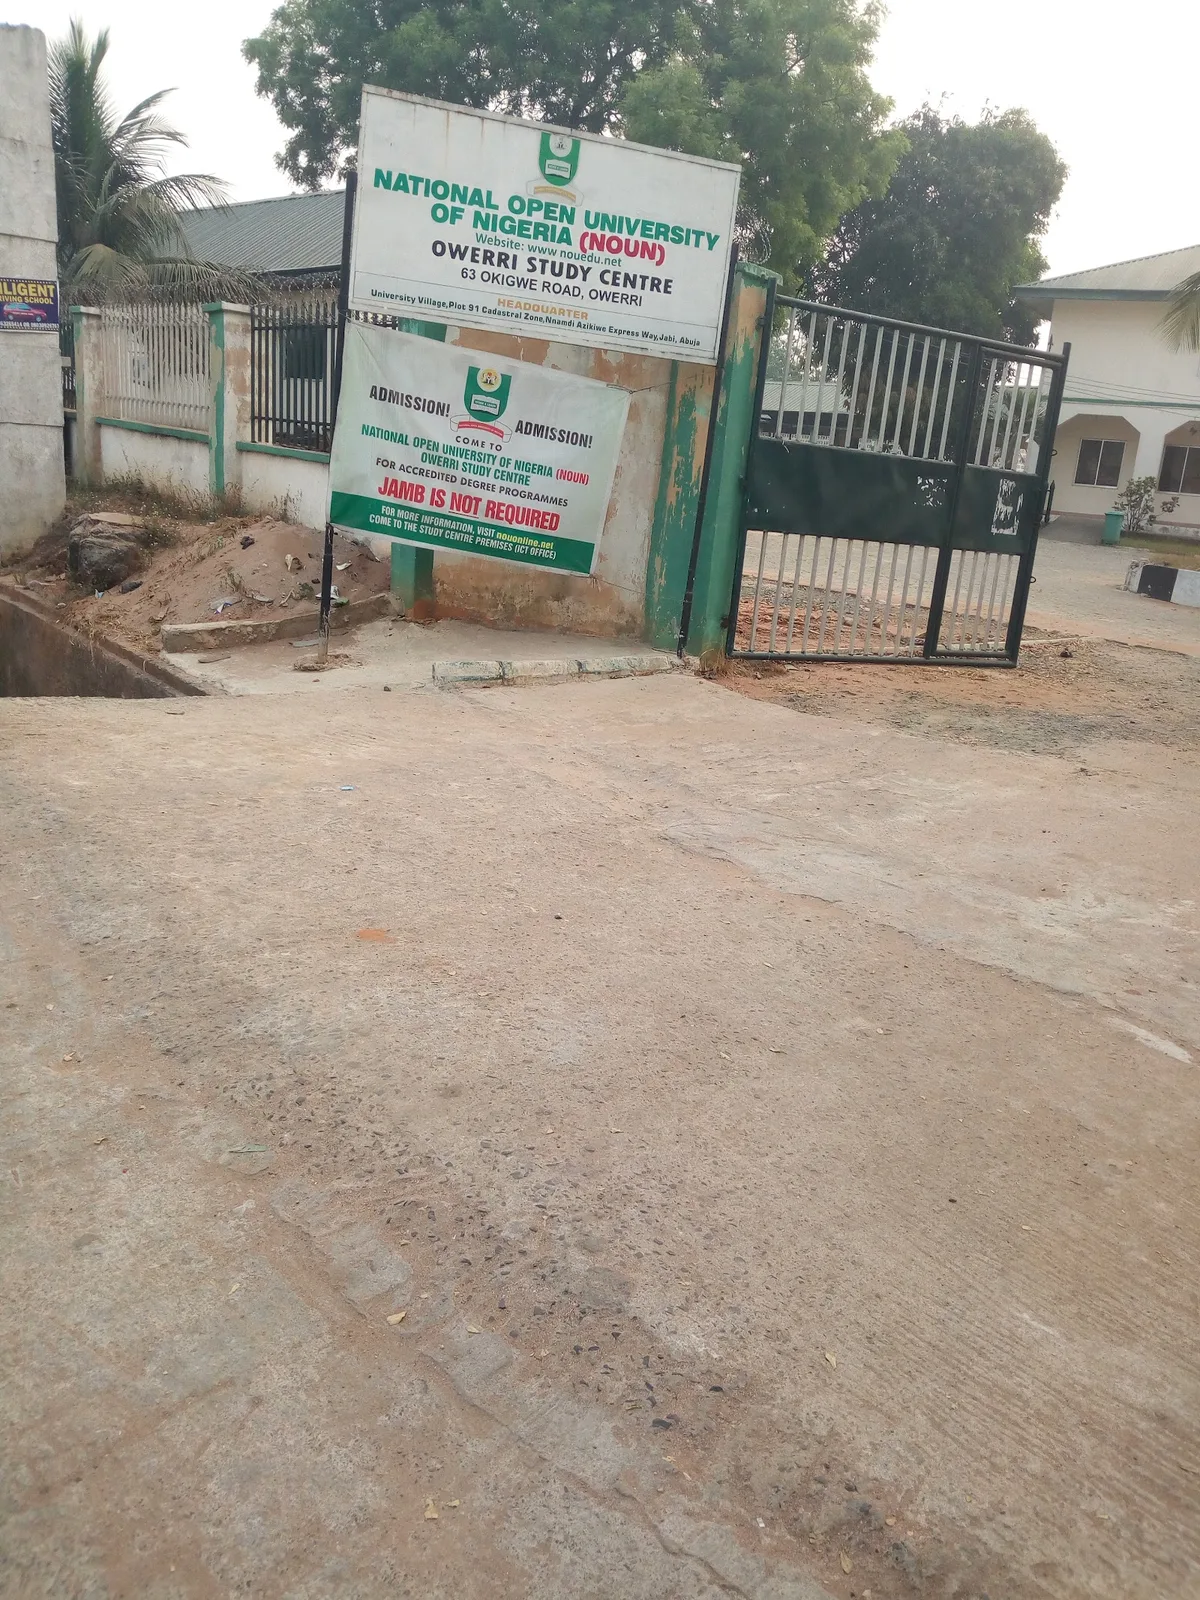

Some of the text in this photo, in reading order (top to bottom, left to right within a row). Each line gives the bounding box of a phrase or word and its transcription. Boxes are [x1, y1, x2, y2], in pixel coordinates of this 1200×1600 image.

[374, 168, 720, 251] NATIONAL OPEN UNIVERSITY
[431, 203, 666, 266] OF NIGERIA (NOUN)
[475, 233, 524, 250] Website:
[432, 240, 673, 294] OWERRI STUDY CENTRE
[461, 268, 642, 306] 63 OKIGWE ROAD, OWERRI
[25, 296, 54, 304] SCHOOL
[371, 289, 416, 304] University
[468, 304, 479, 312] 91
[482, 306, 522, 319] Cadastral
[576, 321, 606, 332] Azikiwe
[609, 326, 639, 337] Express
[680, 336, 700, 346] Abuja
[498, 298, 588, 320] HEADQUARTER
[369, 385, 450, 417] ADMISSION!
[361, 424, 589, 485] NATIONAL OPEN UNIVERSITY OF NIGERIA (NOUN)
[455, 436, 502, 451] COME TO
[515, 420, 593, 448] ADMISSION!
[376, 458, 568, 507] FOR ACCREDITED DEGREE PROGRAMMES
[421, 452, 531, 486] OWERRI STUDY CENTRE
[378, 477, 560, 531] JAMB IS NOT REQUIRED
[369, 514, 556, 560] COME TO THE STUDY CENTRE PREMISES (ICT OFFICE)
[382, 505, 395, 516] FOR
[397, 509, 419, 521] MORE
[477, 526, 495, 537] VISIT
[497, 532, 554, 549] nouonline.net
